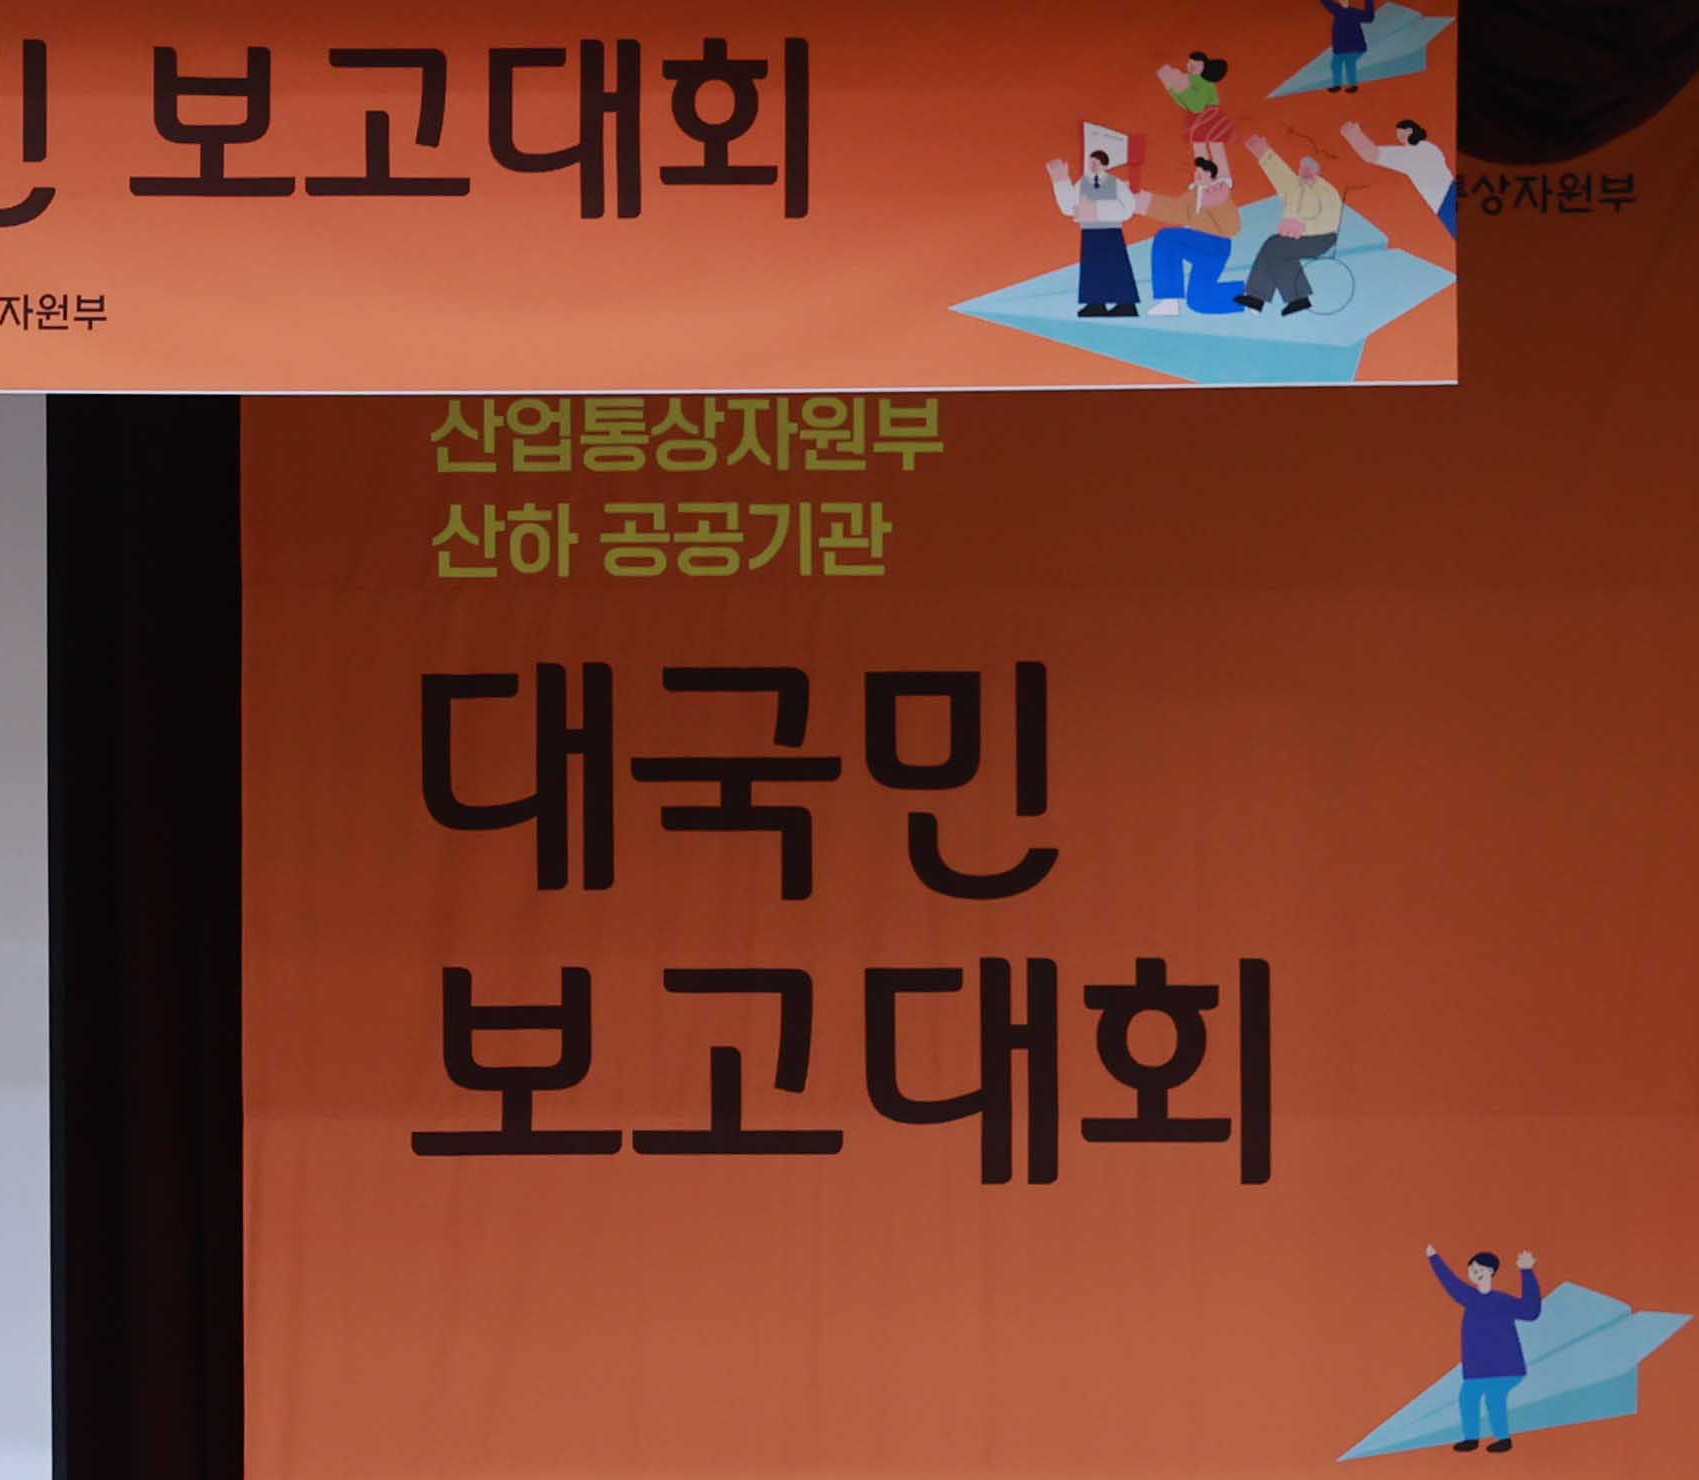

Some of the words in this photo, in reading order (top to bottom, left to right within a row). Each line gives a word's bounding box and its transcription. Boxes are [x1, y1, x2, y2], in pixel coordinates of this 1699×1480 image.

[129, 37, 809, 219] 보고대회
[430, 396, 944, 473] 산업통상자원부
[431, 502, 579, 579] 산하
[599, 501, 893, 577] 공공기관
[420, 660, 1060, 901] 대국민
[410, 957, 1272, 1185] 보고대회
